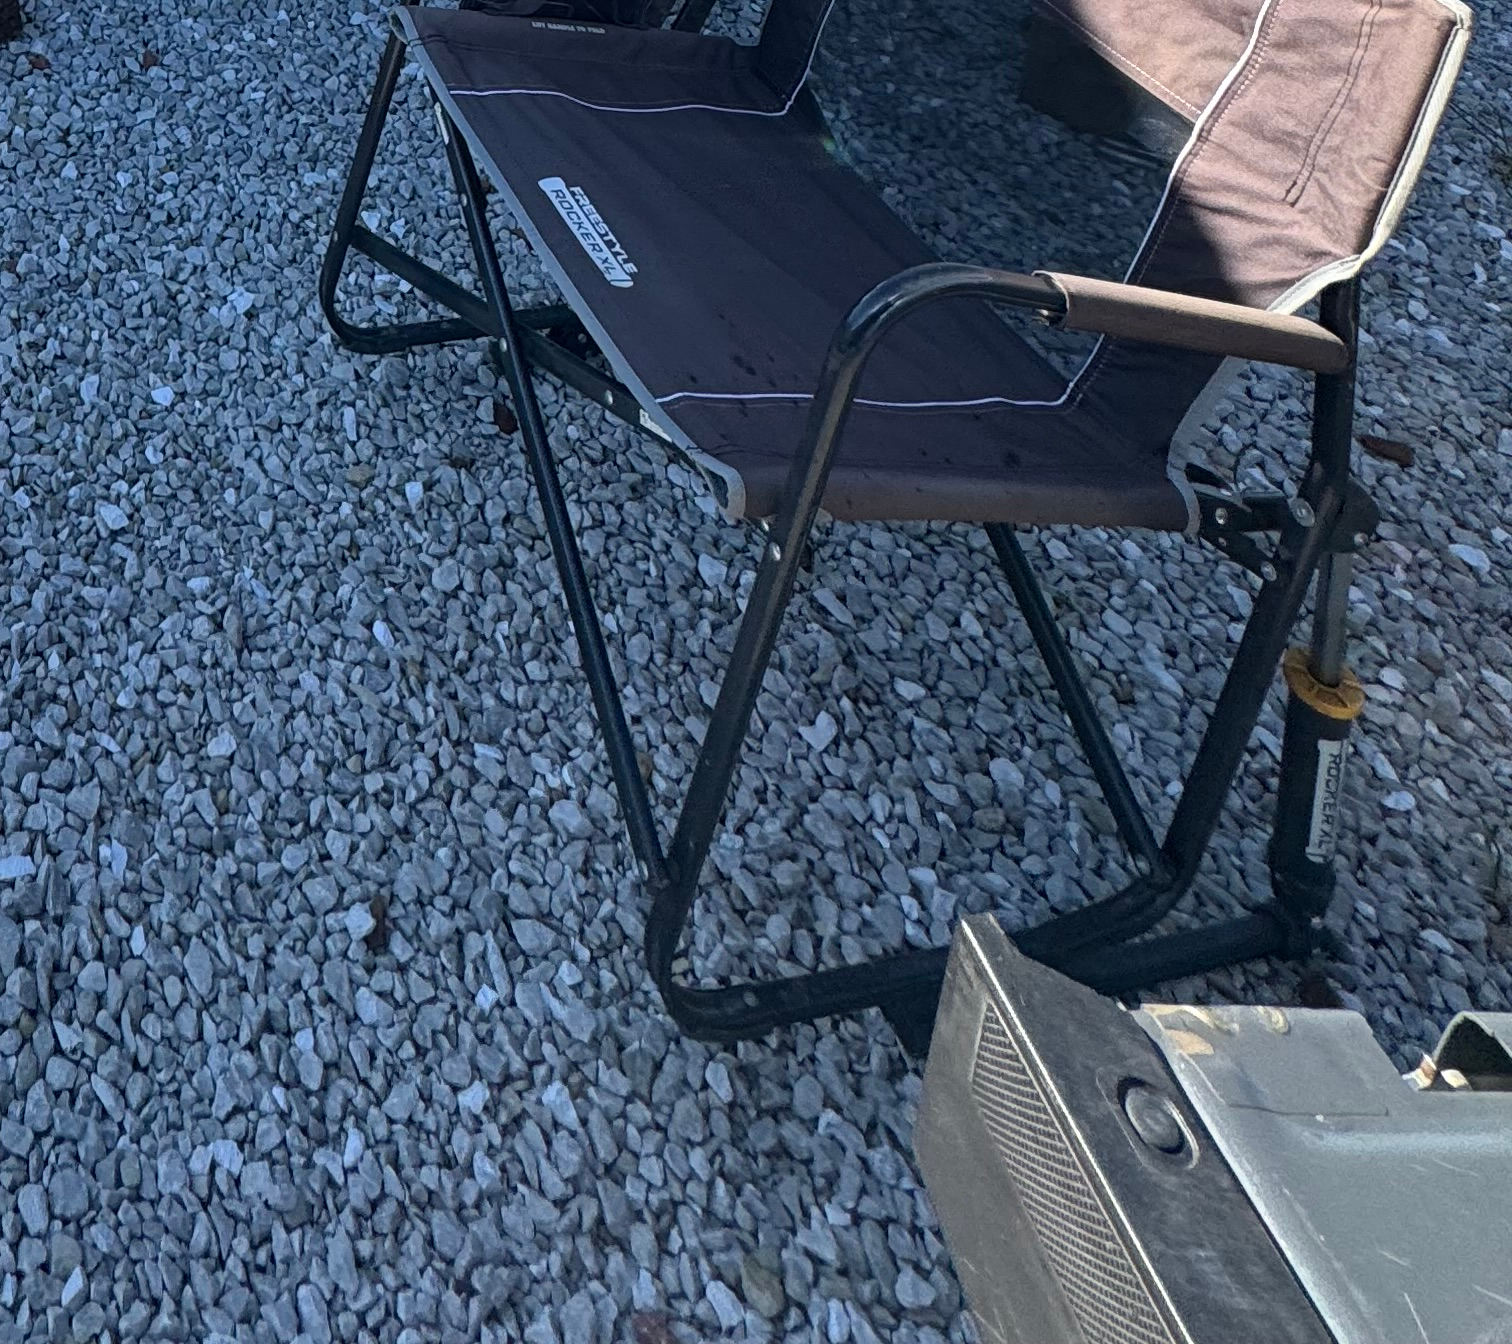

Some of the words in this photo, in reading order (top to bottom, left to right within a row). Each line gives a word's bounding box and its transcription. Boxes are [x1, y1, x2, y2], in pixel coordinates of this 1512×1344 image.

[550, 189, 603, 253] ROCKER
[596, 254, 617, 271] XL
[570, 186, 638, 274] FREESTYLE
